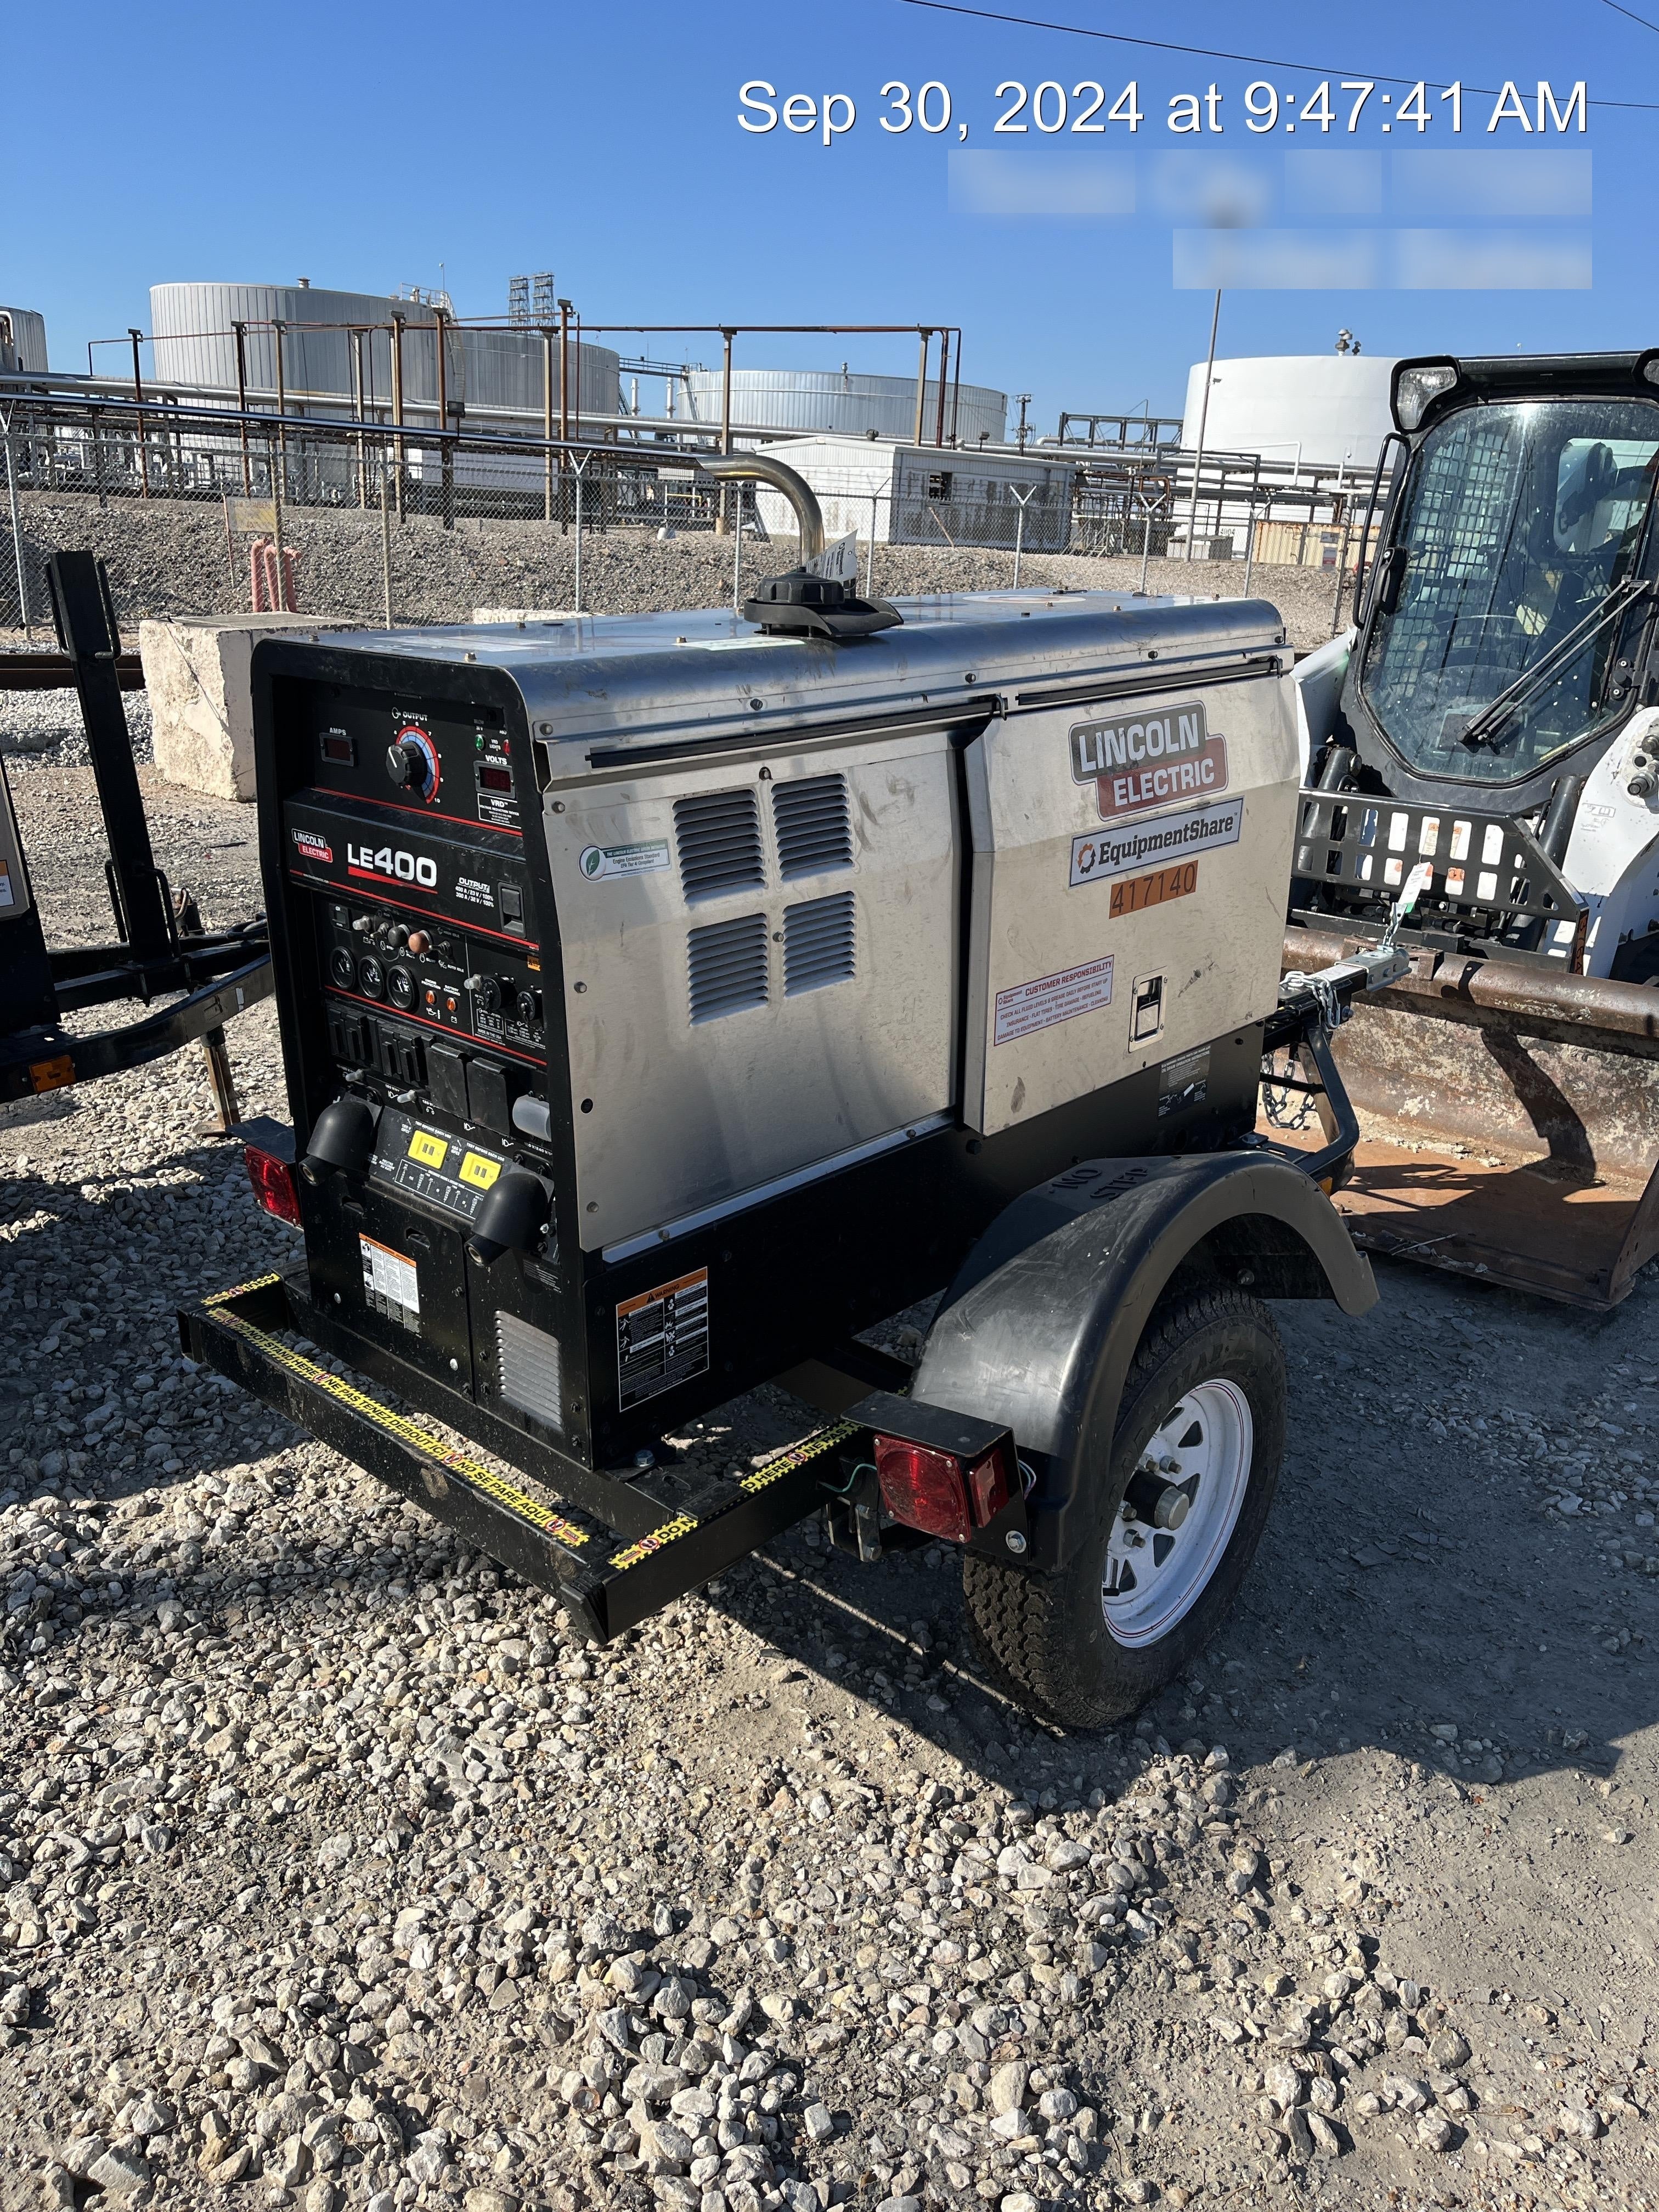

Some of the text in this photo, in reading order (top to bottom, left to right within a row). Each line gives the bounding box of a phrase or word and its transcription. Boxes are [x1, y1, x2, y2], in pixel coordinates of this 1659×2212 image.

[329, 727, 347, 736] AMPS
[403, 711, 427, 721] OUTPUT
[485, 754, 507, 765] VOLTS
[1079, 713, 1199, 772] LINCOLN
[1113, 758, 1215, 808] ELECTRIC
[293, 831, 324, 849] LINCOLN
[302, 845, 329, 860] ELECTRIC
[1098, 815, 1234, 866] EquipmentShare
[347, 843, 437, 887] LE400
[459, 877, 488, 891] OUTPUT
[1111, 863, 1195, 914] 417140
[1003, 960, 1113, 1000] Equipment CUSTOMER RESPONSIBILITY
[997, 1030, 1014, 1041] DAMAGE
[1020, 1019, 1043, 1032] EQUIPMENT
[1045, 1012, 1062, 1023] BATTERY
[1062, 1003, 1088, 1017] MAINTENANCE
[1091, 996, 1108, 1006] CLEANING
[1000, 1011, 1014, 1020] CHECK
[1021, 1004, 1034, 1013] FLUID
[1034, 998, 1047, 1008] LEVELS
[1051, 992, 1065, 1002] GREASE
[1077, 984, 1091, 993] BEFORE
[1091, 980, 1102, 988] START
[1006, 1015, 1030, 1028] INSURANCE
[1041, 1006, 1052, 1014] TIRES
[1064, 997, 1080, 1007] DAMAGE
[1082, 989, 1102, 1000] REFUELING
[1090, 1166, 1149, 1201] STEP
[655, 1284, 680, 1299] WARNING
[235, 1323, 319, 1376] DO NOT STAND HERE
[325, 1378, 448, 1456] NE PAS TENEZ DEBOUT ICI
[803, 1442, 824, 1454] NE
[822, 1428, 848, 1442] PAS
[456, 1462, 477, 1472] NO
[474, 1471, 492, 1485] SE
[489, 1482, 521, 1504] PARE
[755, 1460, 791, 1481] HERE
[657, 1525, 685, 1541] DO
